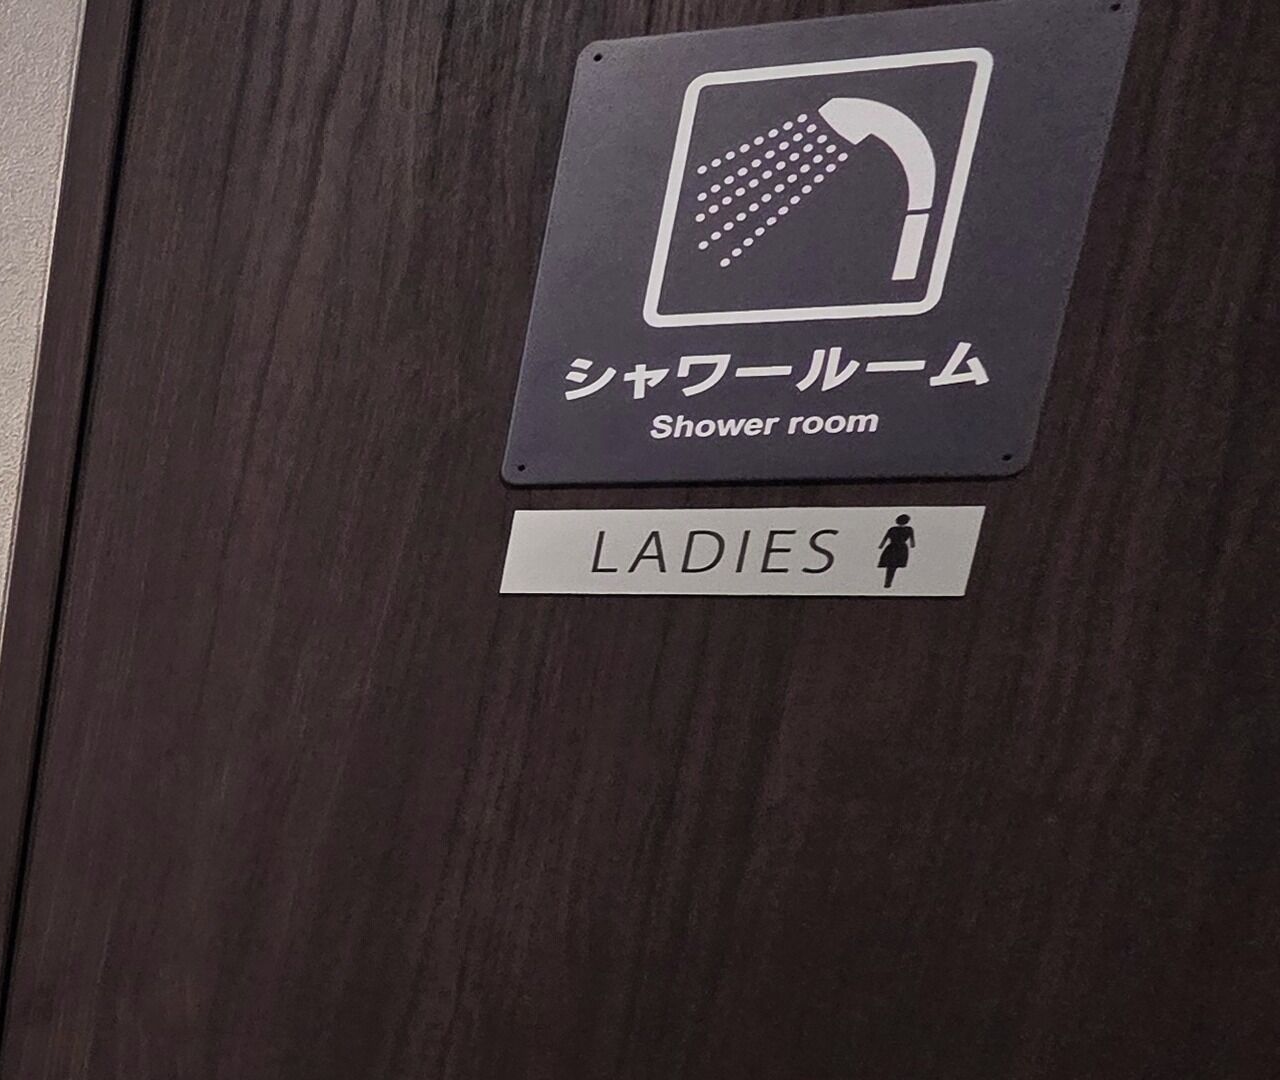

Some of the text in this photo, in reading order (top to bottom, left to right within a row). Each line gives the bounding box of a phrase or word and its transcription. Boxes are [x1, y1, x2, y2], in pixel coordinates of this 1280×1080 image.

[564, 342, 990, 401] シャワールーム
[649, 412, 879, 440] Shower room
[591, 527, 840, 575] LADIES
